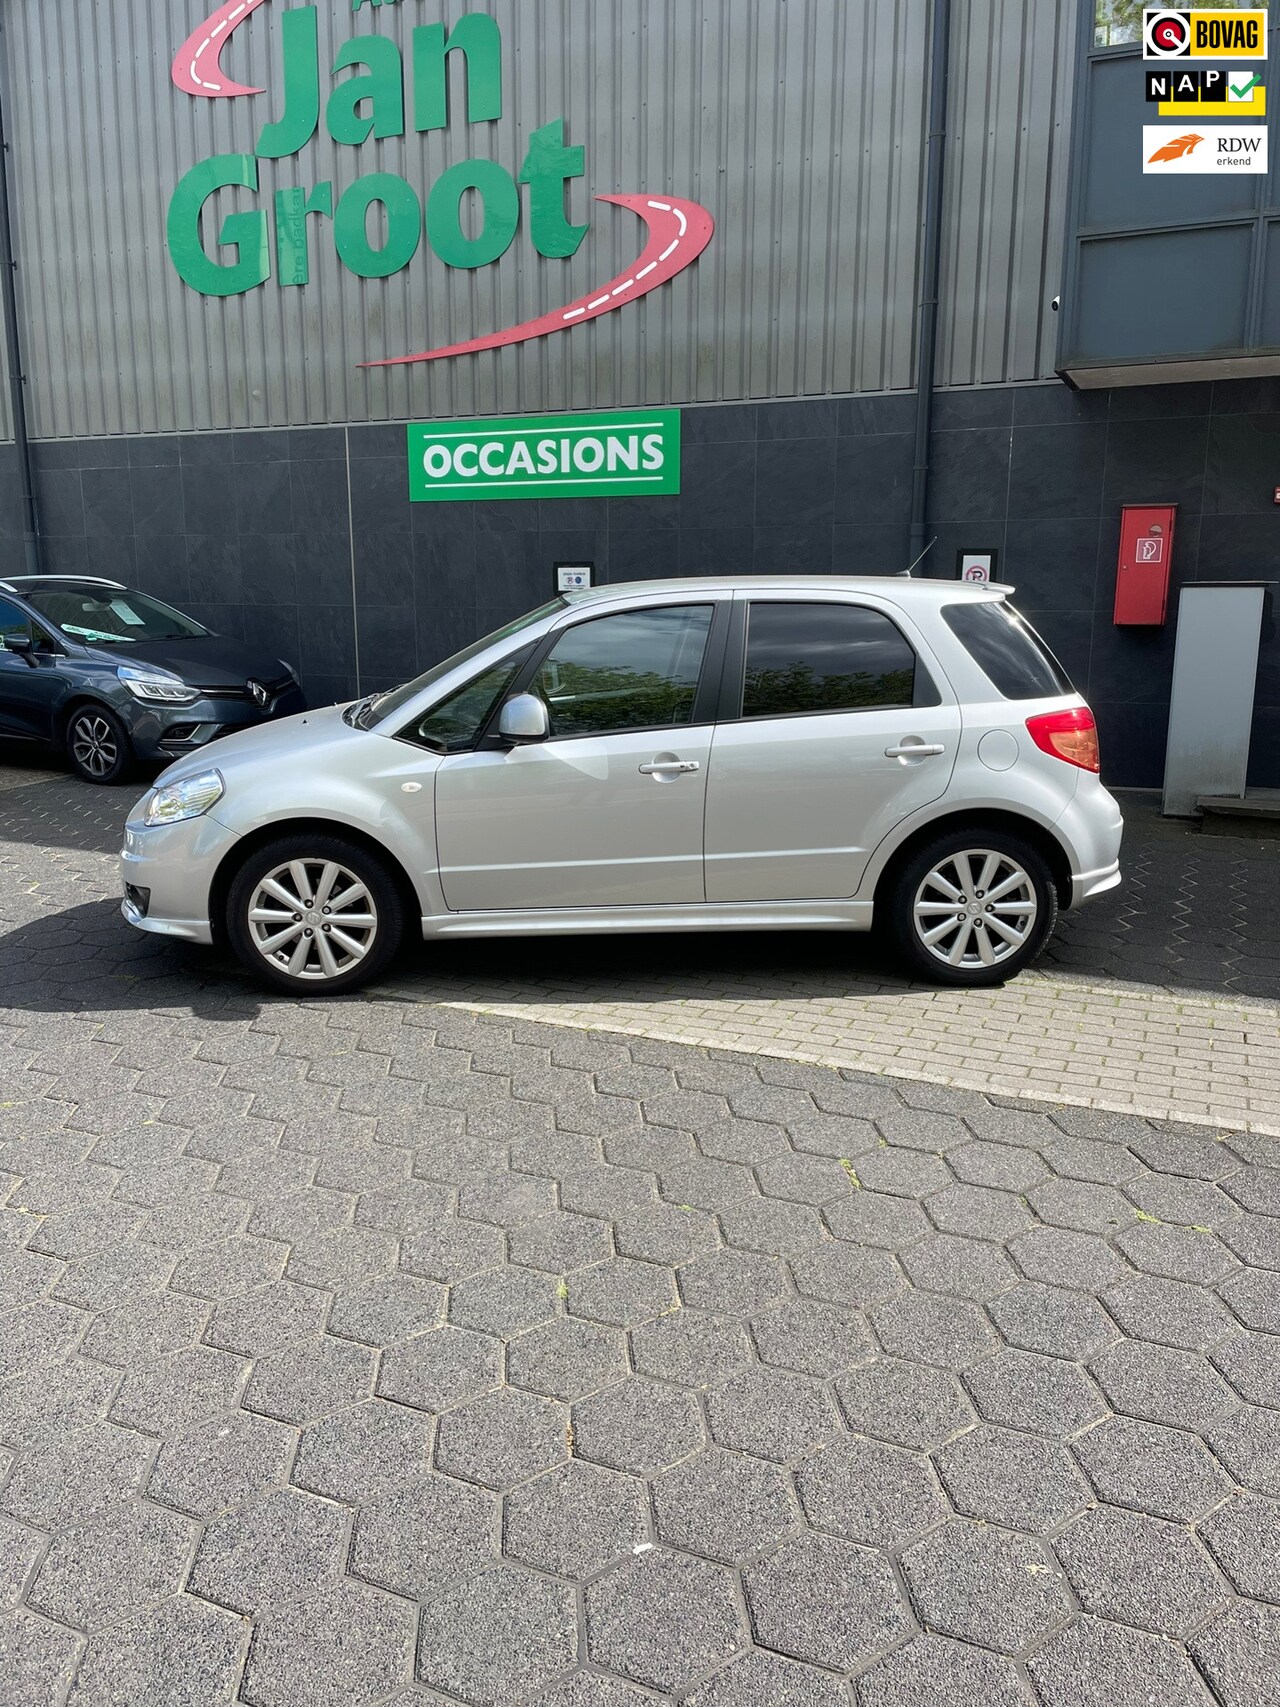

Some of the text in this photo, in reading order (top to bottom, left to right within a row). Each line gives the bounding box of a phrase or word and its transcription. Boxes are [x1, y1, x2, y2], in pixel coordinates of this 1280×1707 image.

[256, 5, 502, 158] Jan
[167, 117, 590, 297] Groot
[423, 434, 665, 477] OCCASIONS
